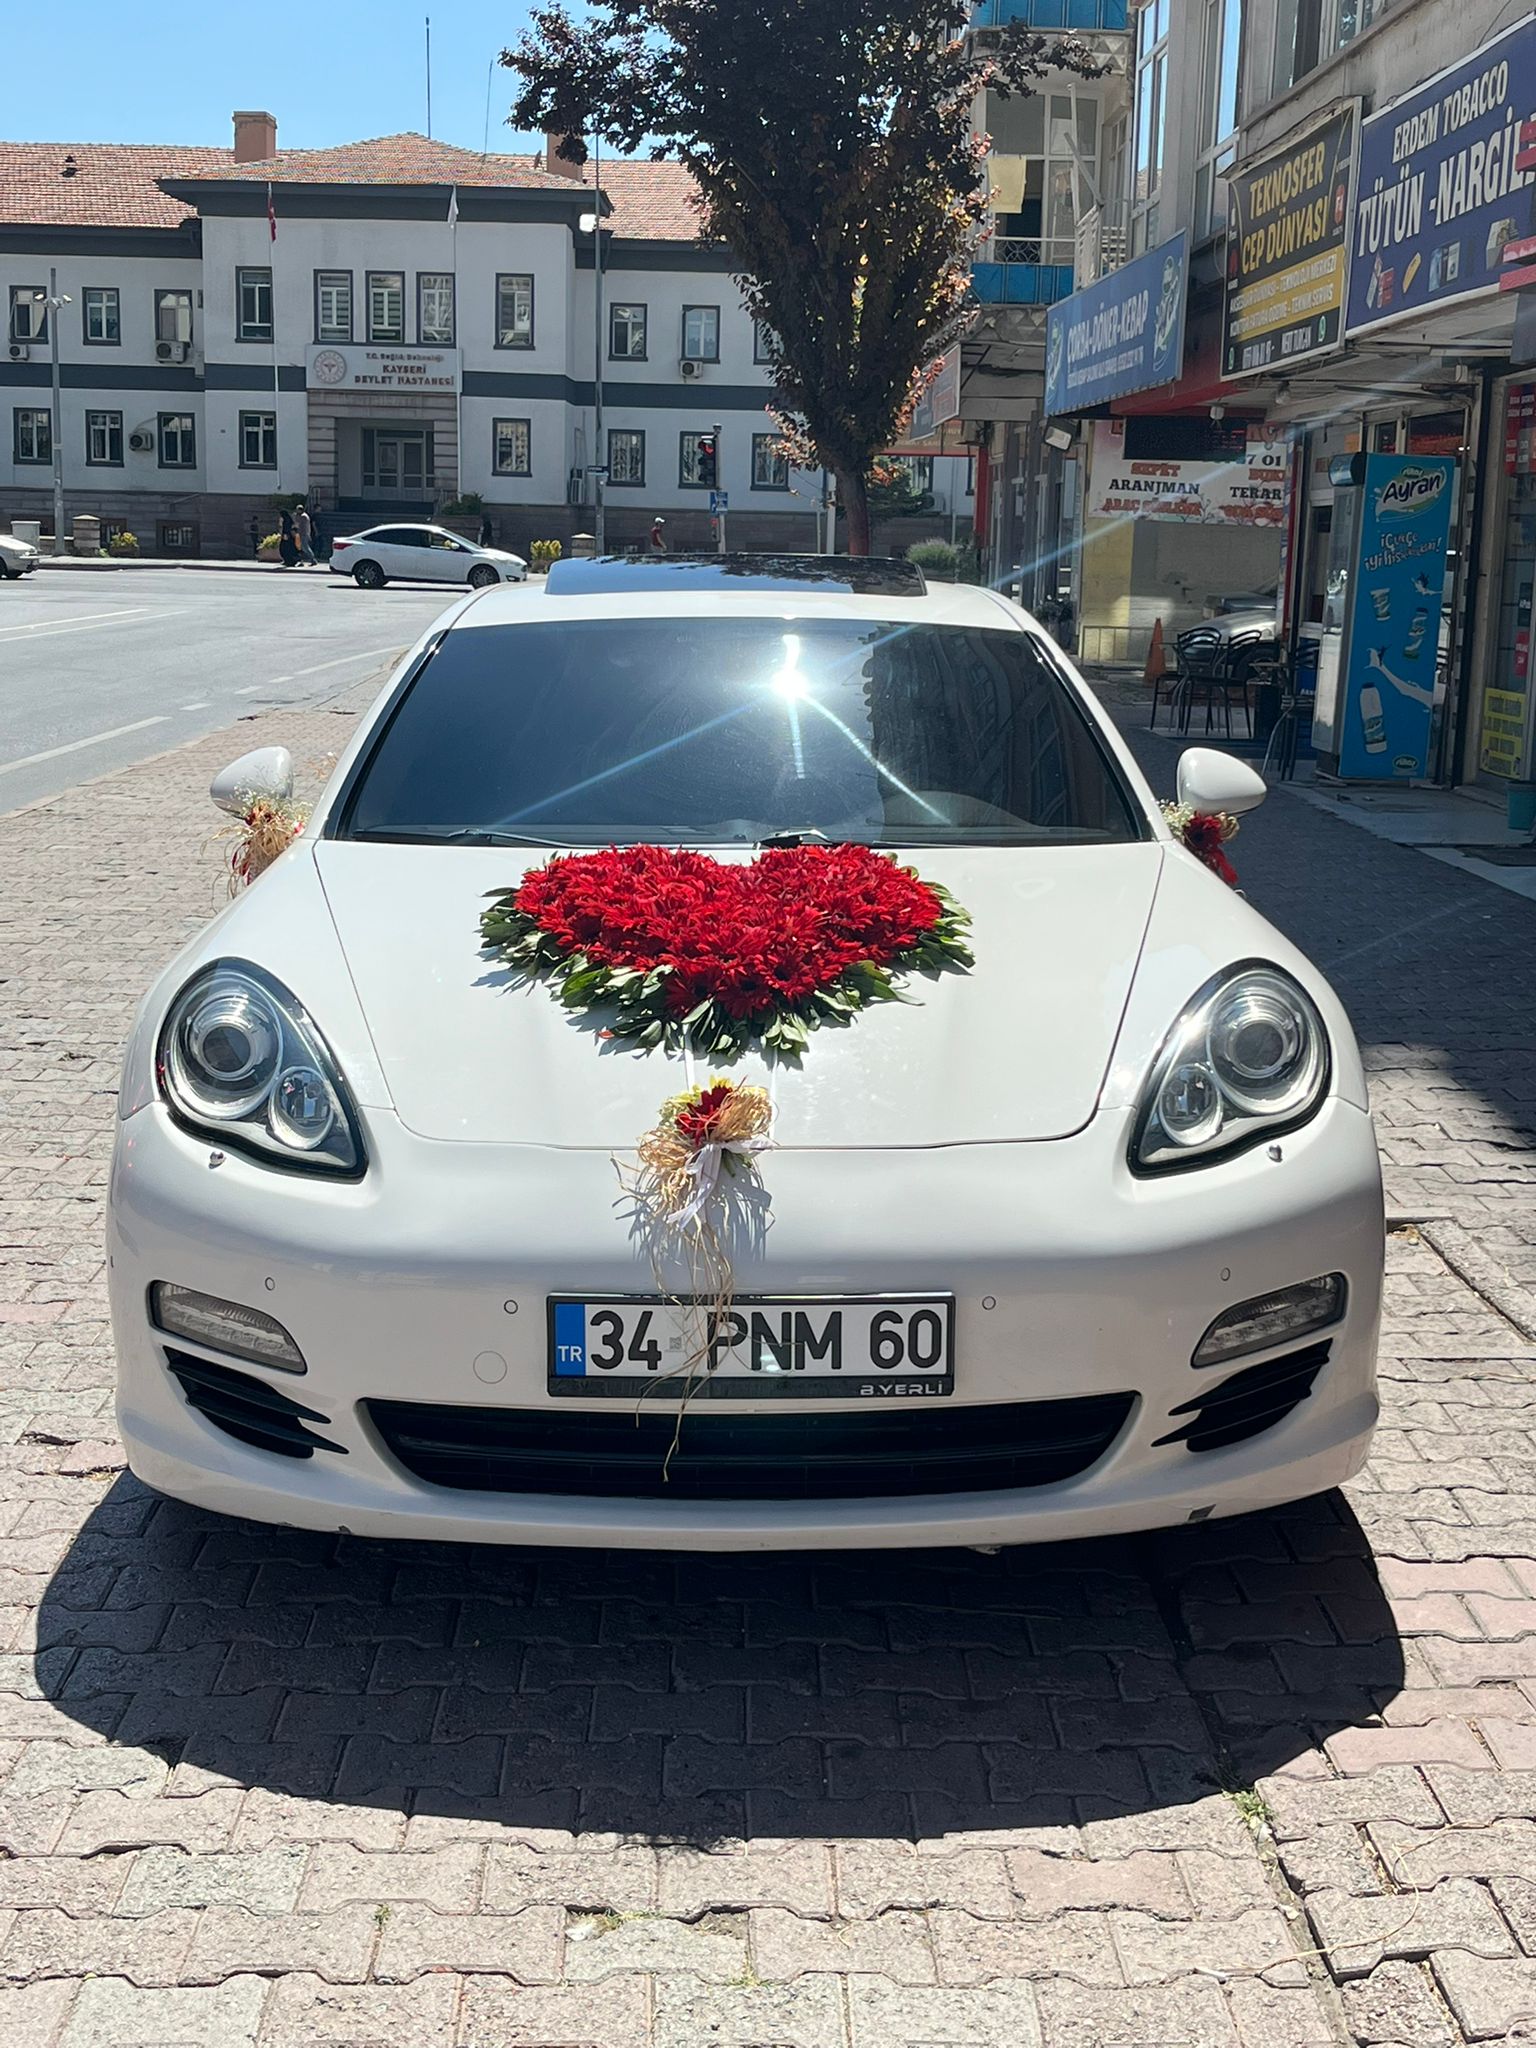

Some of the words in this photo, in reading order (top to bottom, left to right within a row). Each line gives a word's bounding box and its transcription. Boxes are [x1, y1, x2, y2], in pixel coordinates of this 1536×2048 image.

[1392, 102, 1440, 163] ERDEM
[1443, 59, 1509, 136] TOBACCO
[1250, 141, 1325, 220] TEKNOSFER
[1357, 164, 1426, 257] TÜTÜN
[1242, 229, 1265, 275] CEP
[1266, 195, 1329, 264] DÜNYASI
[354, 375, 393, 385] DEVLET
[398, 375, 454, 386] HASTANESİ
[383, 364, 426, 374] KAYSERİ
[1109, 479, 1200, 495] ARANJMAN
[1383, 474, 1441, 504] Ayran
[558, 1346, 582, 1362] TR
[590, 1310, 662, 1371] 34
[706, 1310, 842, 1371] PNM
[869, 1309, 942, 1370] 60
